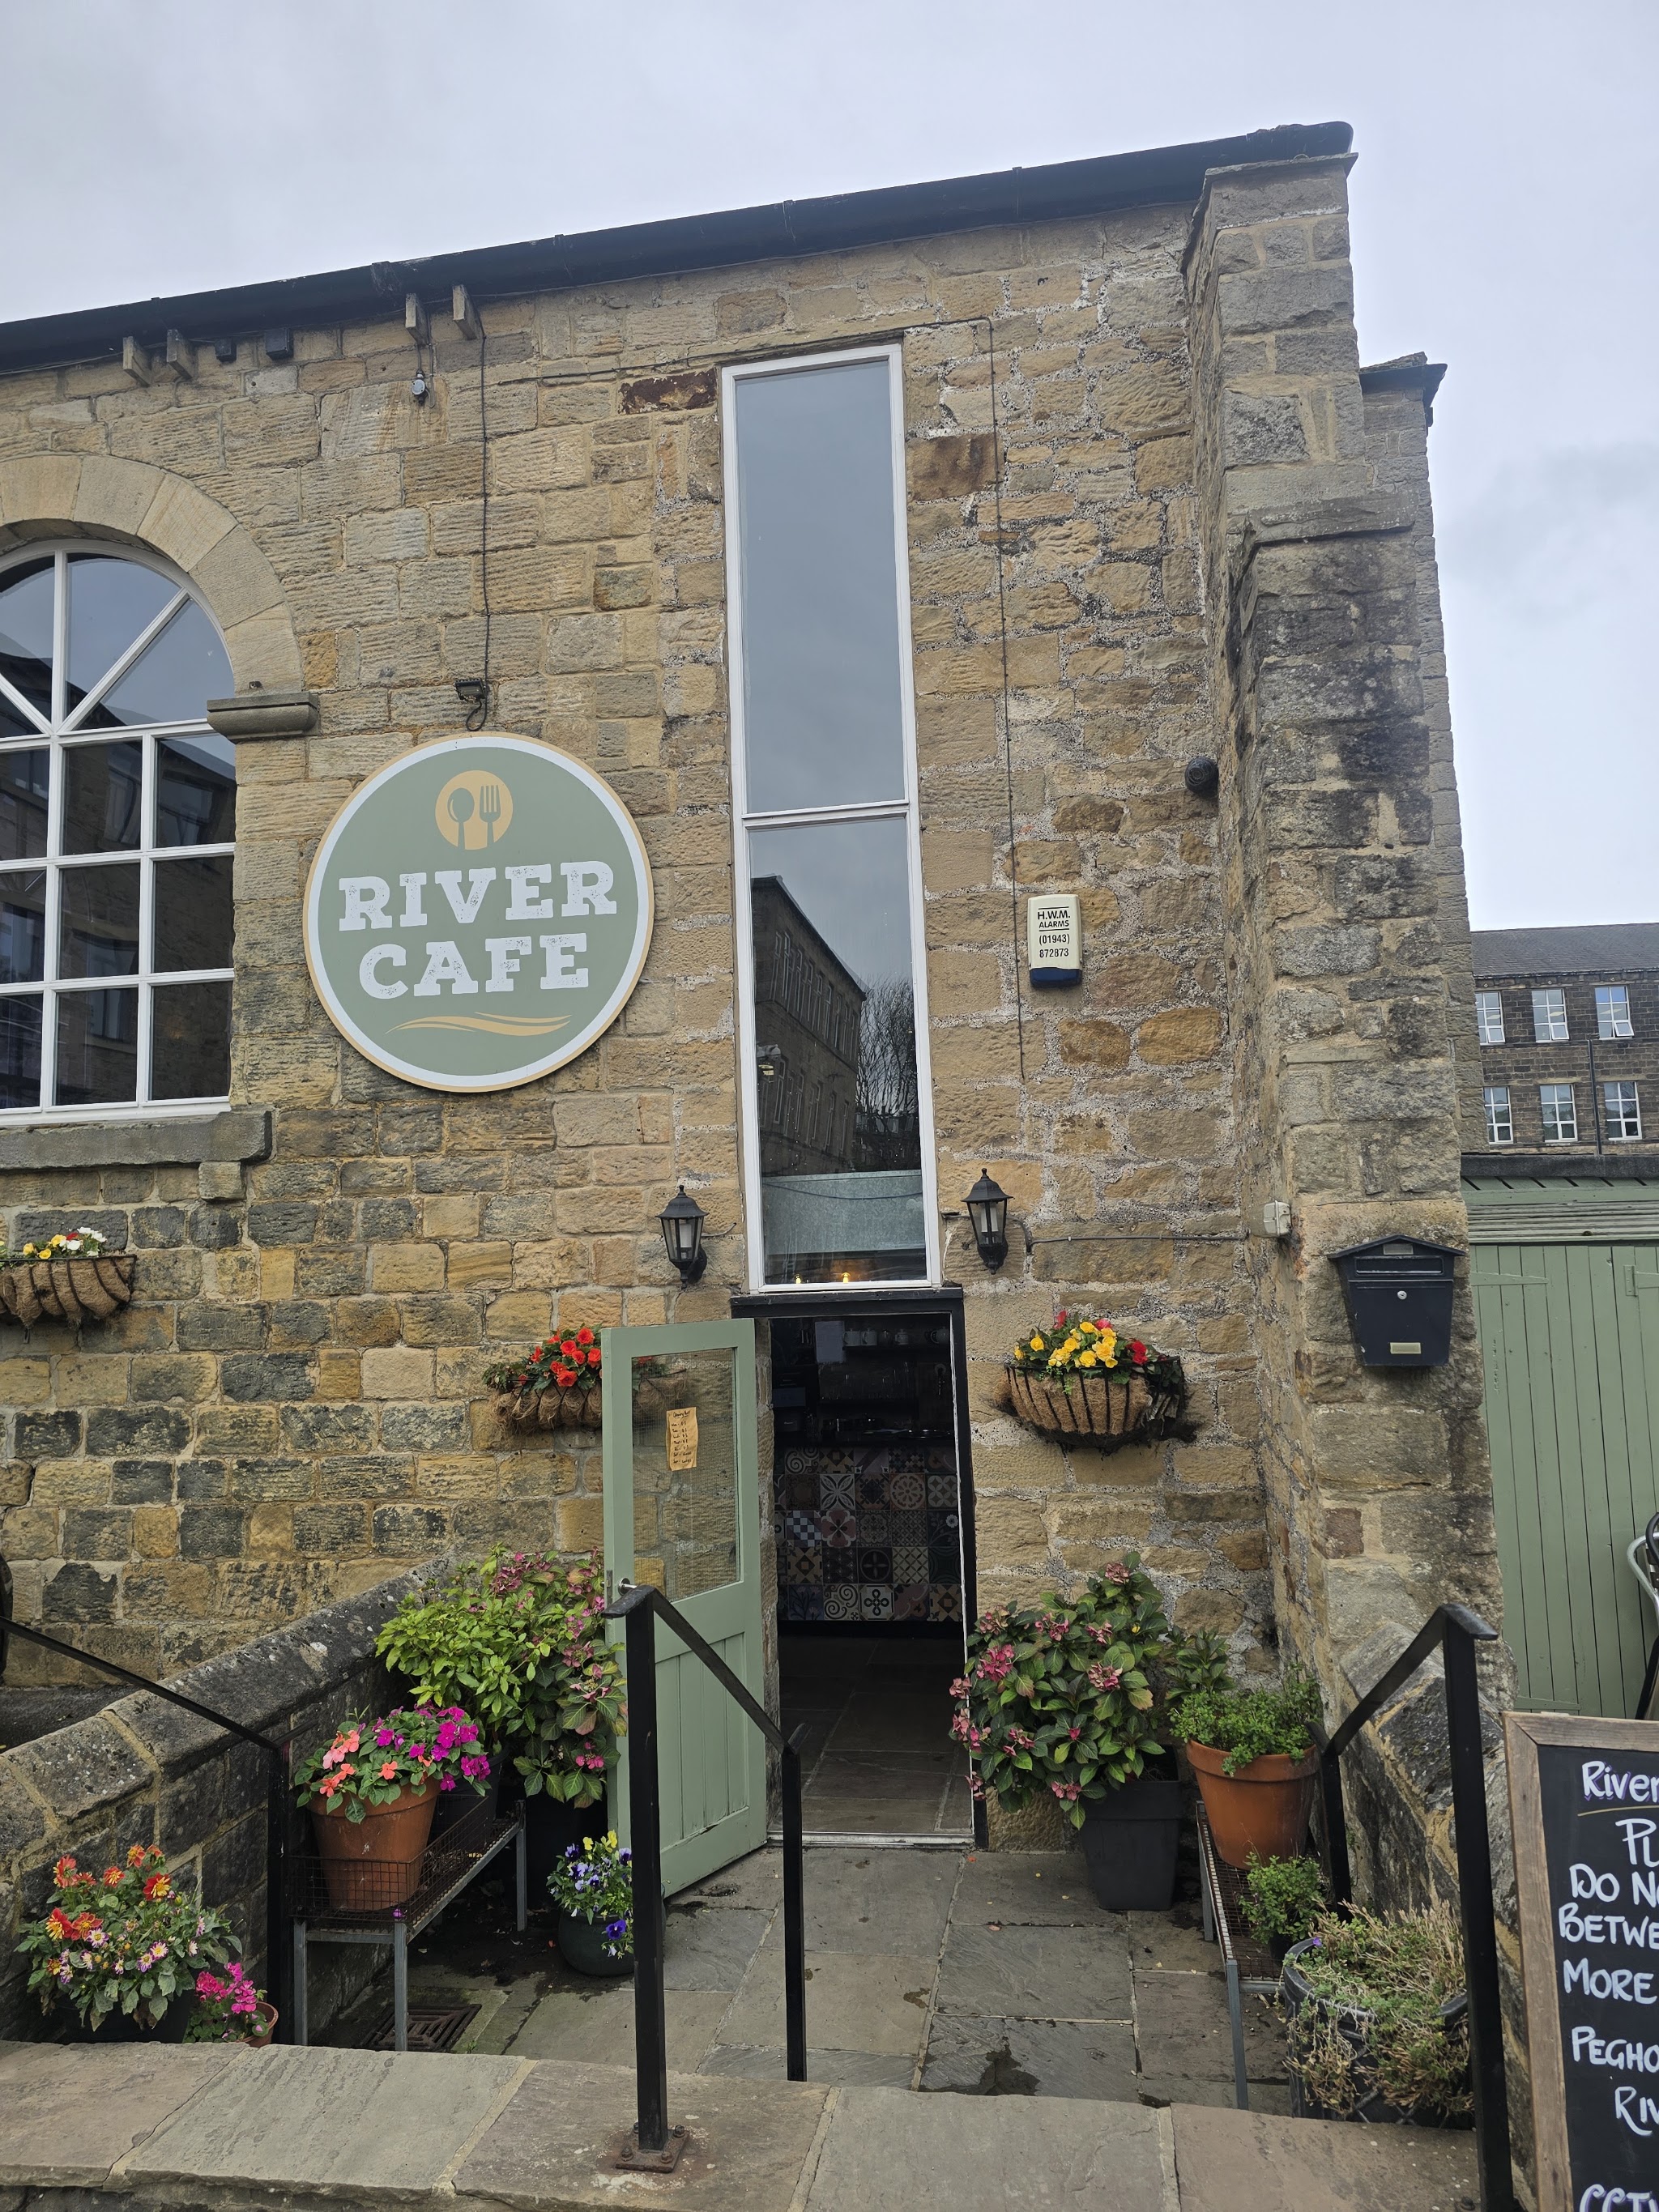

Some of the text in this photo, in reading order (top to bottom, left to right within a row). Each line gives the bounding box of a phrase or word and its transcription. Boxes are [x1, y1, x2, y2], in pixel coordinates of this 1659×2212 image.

[339, 860, 617, 931] RIVER
[1037, 910, 1071, 920] H.W.M.
[1038, 919, 1069, 929] ALARMS
[1038, 933, 1070, 946] (01943)
[1039, 948, 1069, 958] 872873
[359, 932, 589, 999] CAFE
[1569, 1863, 1659, 1908] DO N
[1563, 1957, 1658, 2005] MORE
